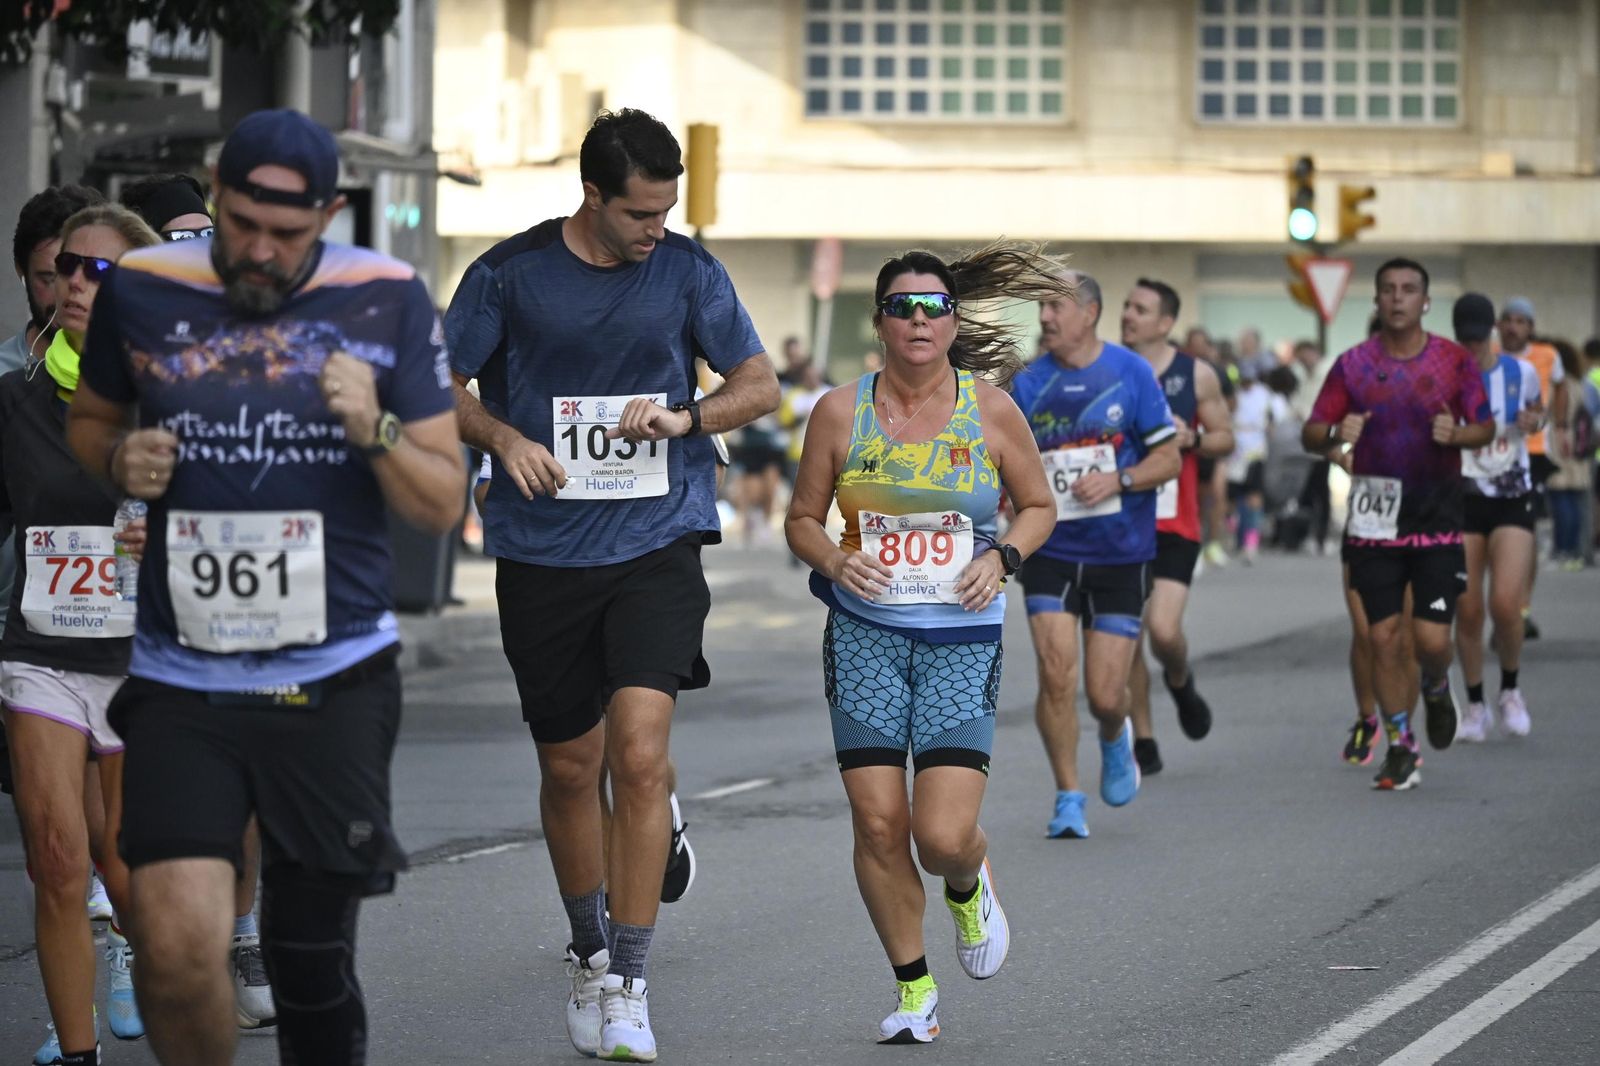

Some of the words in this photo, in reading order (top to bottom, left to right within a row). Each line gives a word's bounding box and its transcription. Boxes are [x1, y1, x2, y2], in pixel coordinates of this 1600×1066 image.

[585, 478, 634, 491] Huelva
[878, 530, 954, 567] 809
[46, 556, 117, 597] 729
[191, 550, 289, 600] 961
[888, 582, 937, 595] Huelva
[51, 613, 104, 628] Huelva
